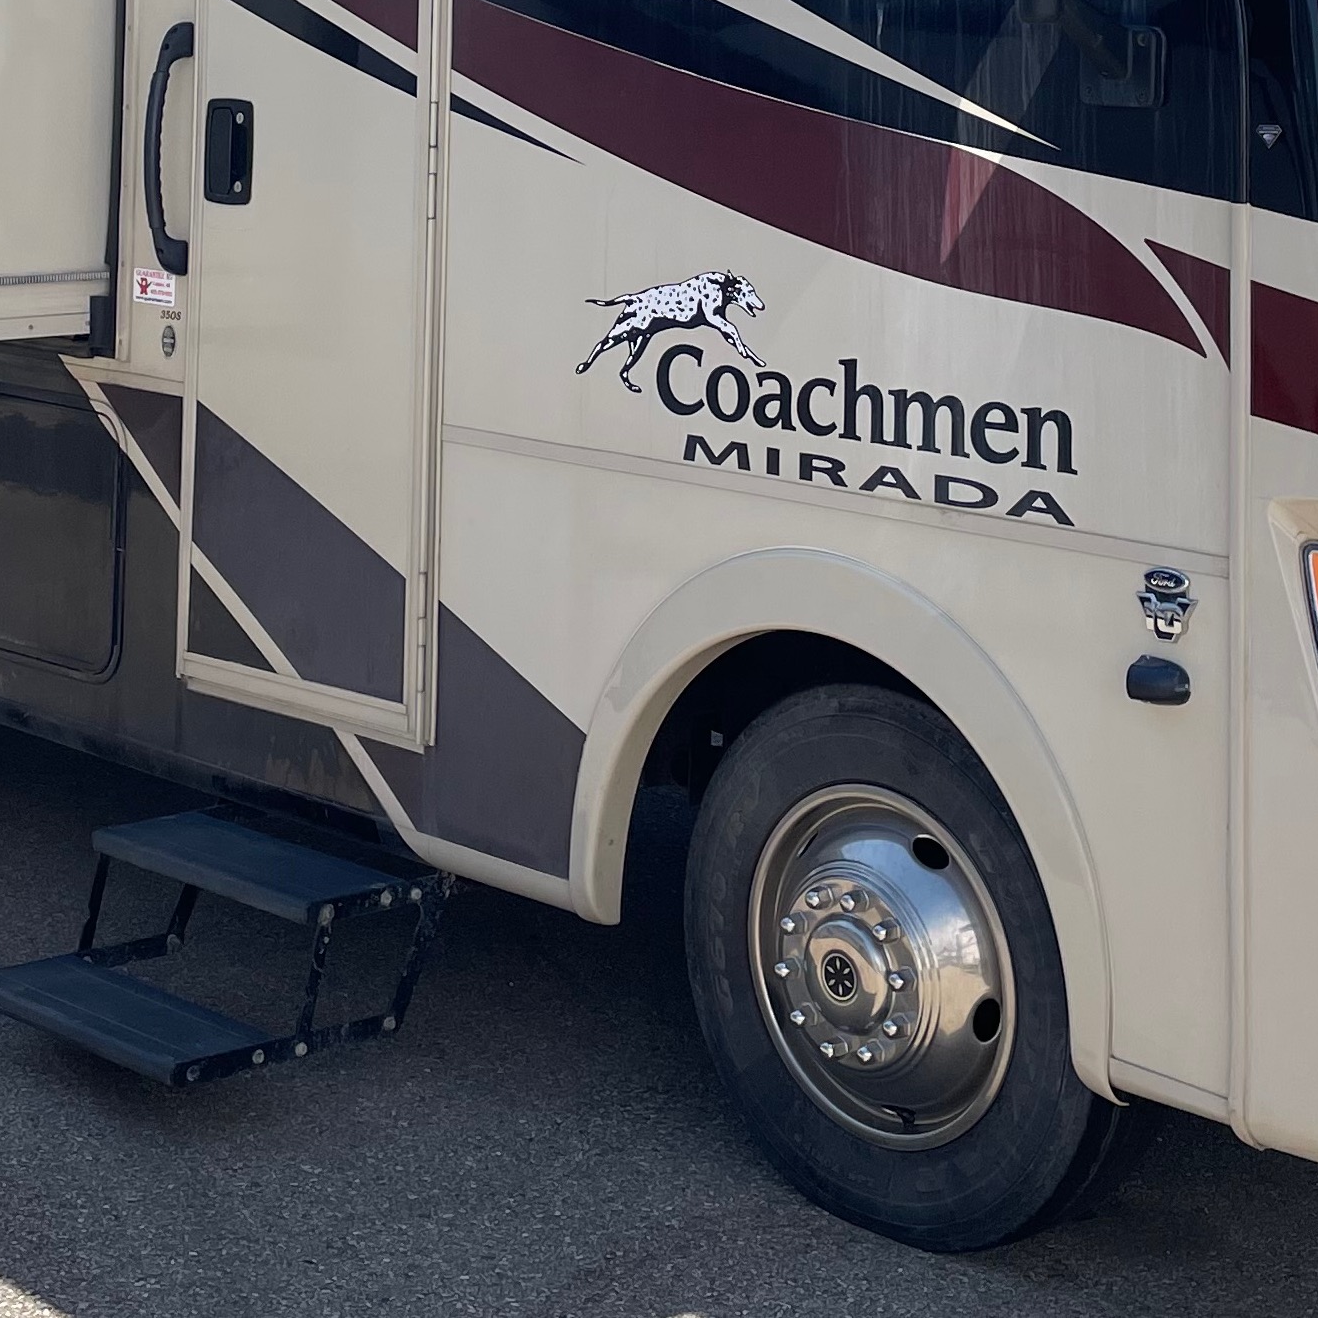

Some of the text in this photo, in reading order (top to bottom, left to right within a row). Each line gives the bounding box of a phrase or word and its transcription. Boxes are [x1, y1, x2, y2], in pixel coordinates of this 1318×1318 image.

[160, 309, 182, 321] 350S
[656, 343, 1078, 475] Coachmen
[682, 434, 1076, 527] MIRADA
[1150, 572, 1177, 588] Ford
